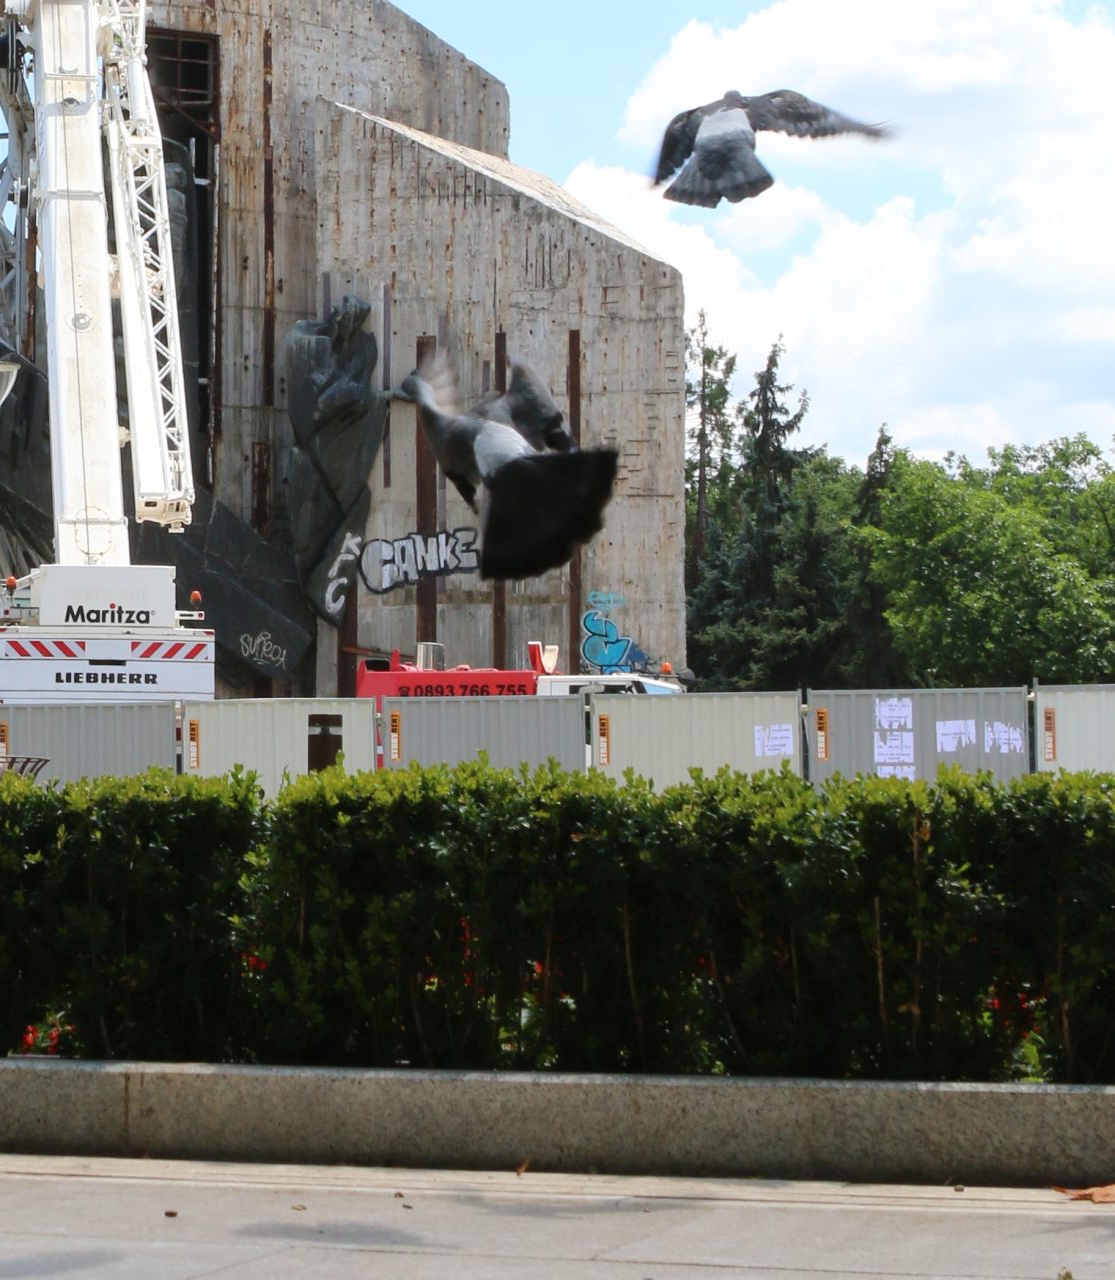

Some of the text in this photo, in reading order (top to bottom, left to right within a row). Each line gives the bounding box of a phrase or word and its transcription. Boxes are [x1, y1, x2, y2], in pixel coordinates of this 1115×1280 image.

[65, 603, 149, 624] Maritza
[55, 672, 158, 685] LIEBHERR
[413, 684, 527, 697] 0893 766 755
